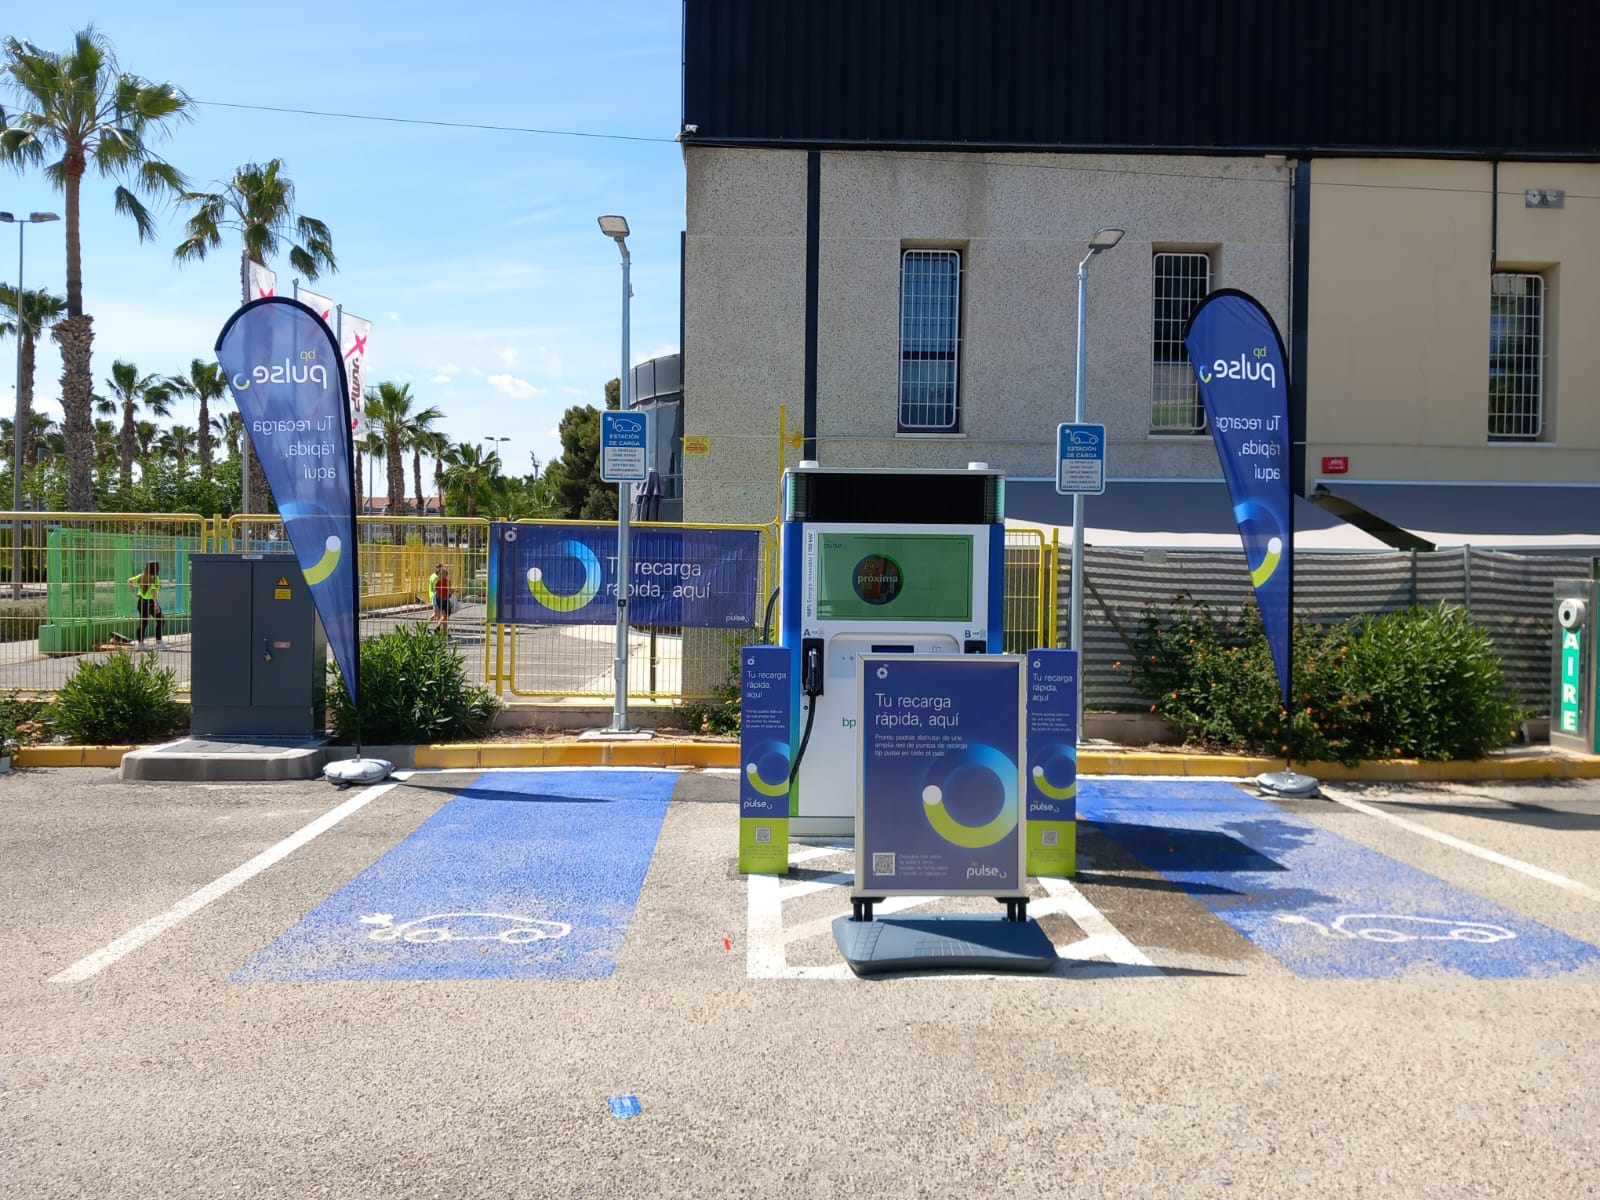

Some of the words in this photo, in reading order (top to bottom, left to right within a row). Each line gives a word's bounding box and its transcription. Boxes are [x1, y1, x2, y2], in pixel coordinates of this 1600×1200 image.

[635, 561, 701, 580] recarga
[857, 573, 898, 584] próxima
[672, 582, 711, 601] aquí
[804, 628, 810, 636] A
[964, 630, 971, 638] B
[747, 670, 756, 679] Tu
[758, 671, 787, 681] recarga
[1033, 673, 1042, 681] Tu
[1044, 675, 1073, 684] recarga
[1562, 631, 1579, 730] AIRE
[875, 692, 892, 708] Tu
[898, 696, 951, 711] recarga
[842, 716, 857, 728] bp
[875, 711, 922, 729] rápida,
[928, 712, 960, 729] aquí
[743, 800, 767, 810] pulse
[1030, 802, 1054, 812] pulse
[966, 864, 999, 879] pulse
